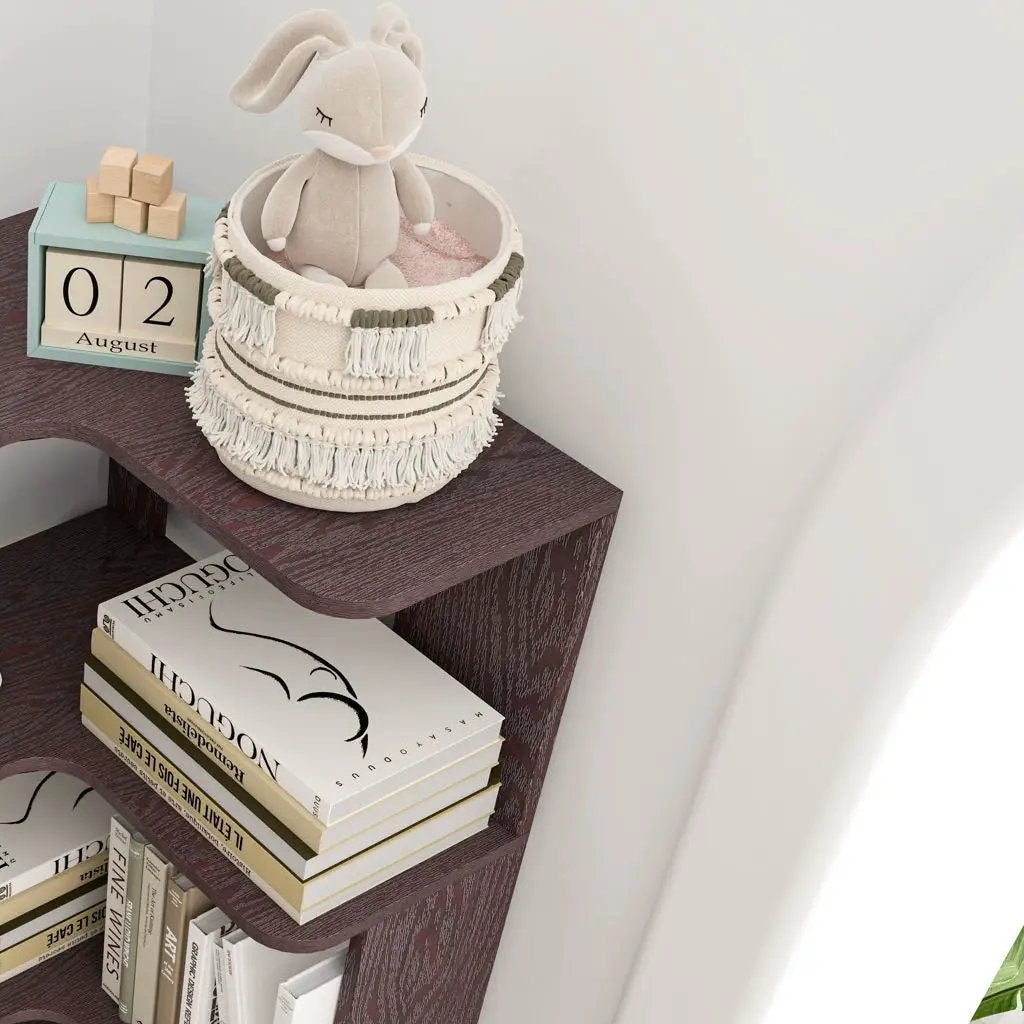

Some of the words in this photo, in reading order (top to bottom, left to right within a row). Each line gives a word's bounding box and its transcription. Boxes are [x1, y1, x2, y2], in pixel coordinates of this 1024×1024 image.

[76, 332, 158, 354] August
[151, 652, 280, 783] NOGUCHI
[119, 726, 143, 759] CAFÉ
[164, 703, 245, 784] Remodelista
[144, 749, 156, 771] LE
[158, 763, 180, 793] FOIS
[181, 782, 202, 811] UNE
[312, 795, 322, 818] DUUS
[203, 804, 232, 842] ÉTAIT
[54, 834, 111, 875] CHI
[233, 831, 244, 851] IL
[111, 848, 127, 904] FINE
[46, 924, 74, 949] CAFÉ
[77, 915, 89, 933] LE
[106, 908, 123, 981] WINES
[164, 925, 178, 962] ART
[188, 941, 198, 978] GRAPHIC
[185, 978, 195, 1007] DESIGN
